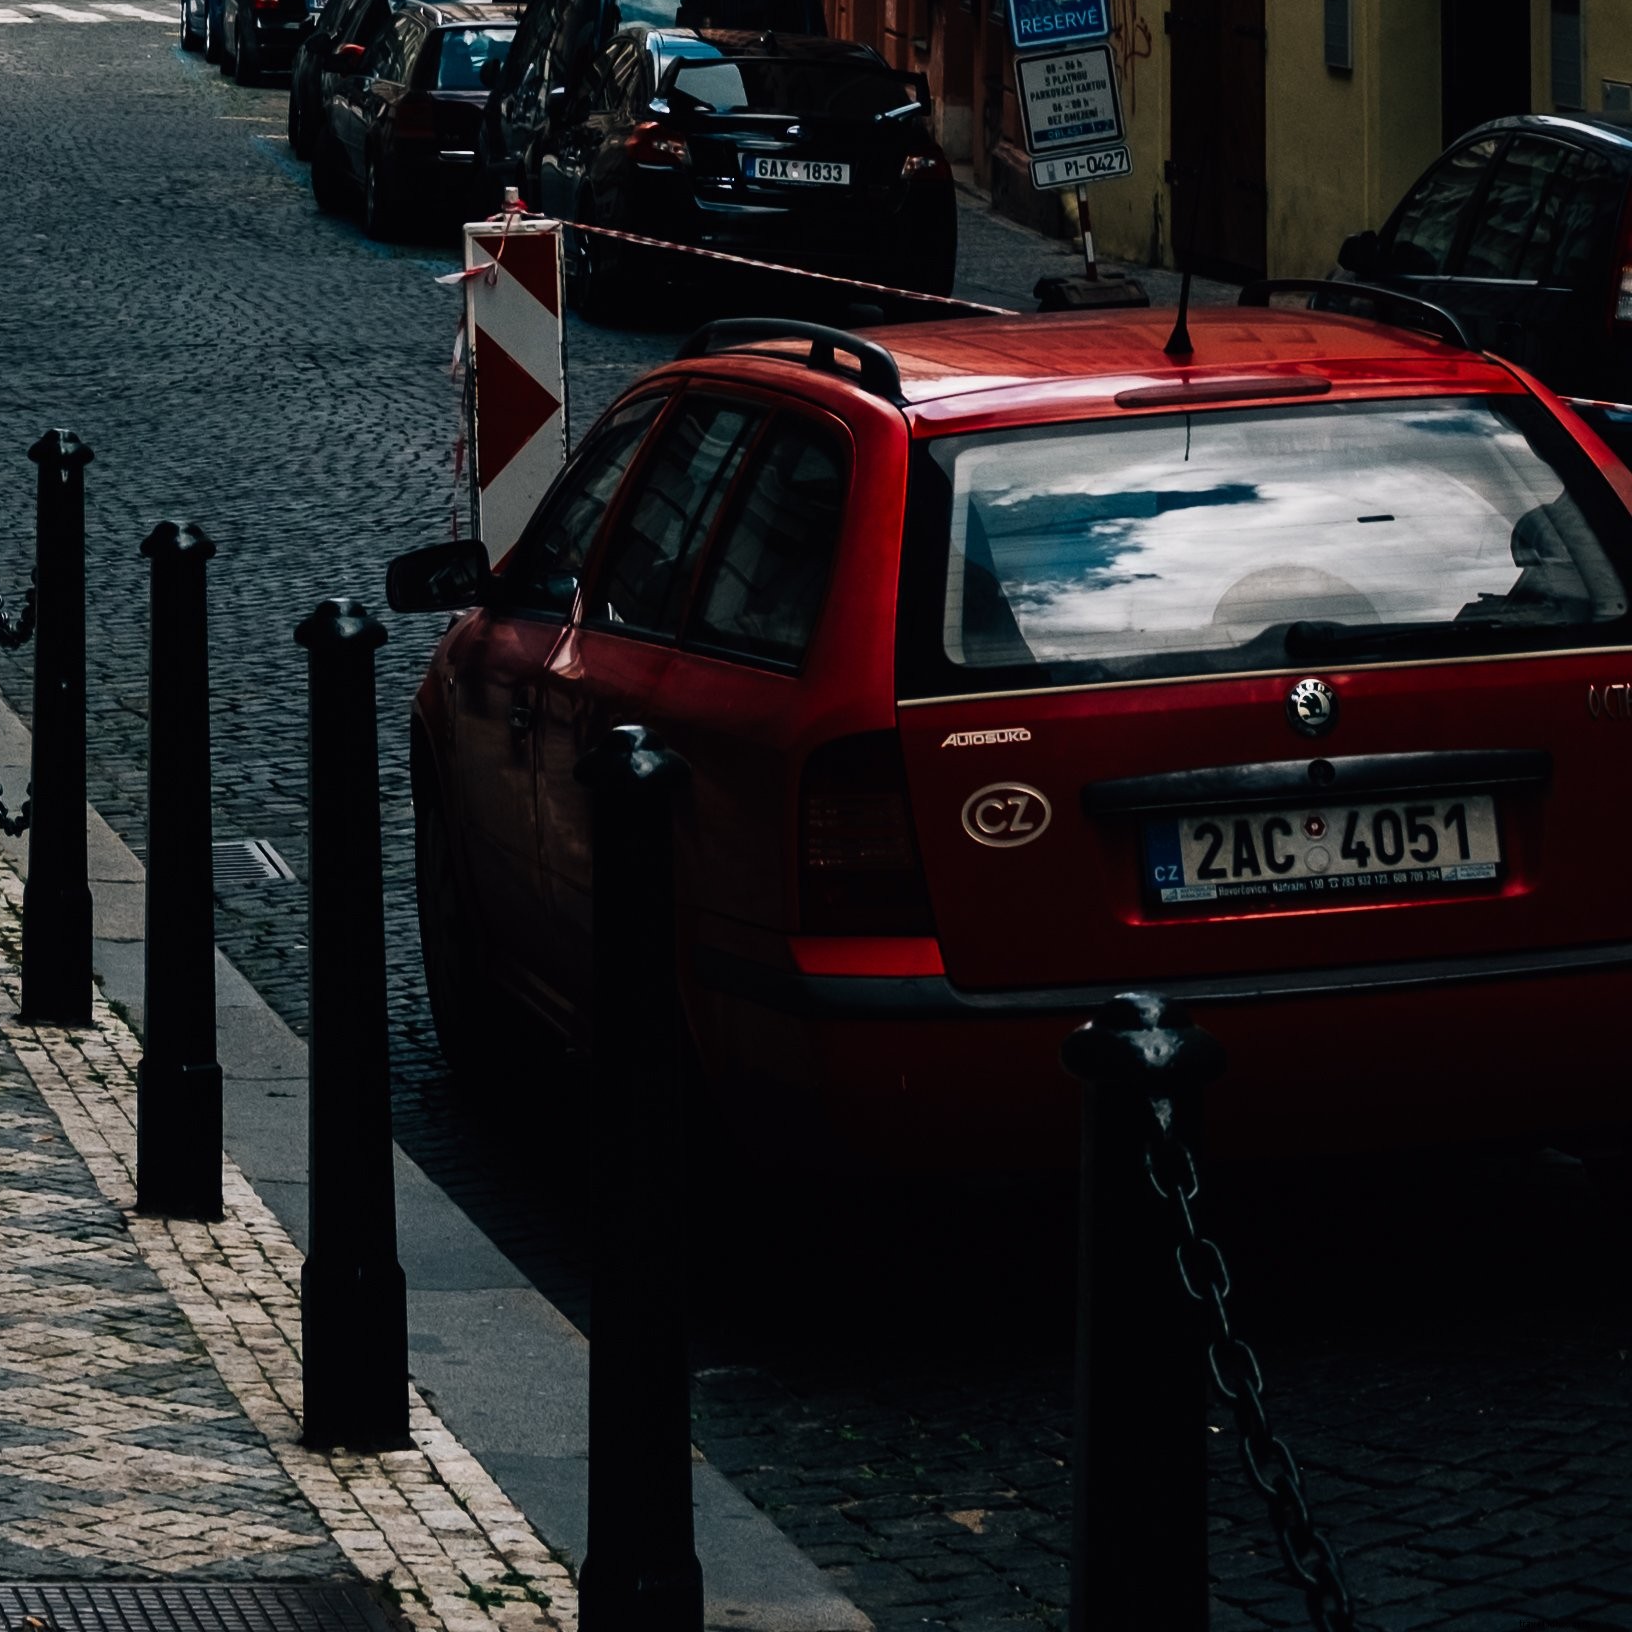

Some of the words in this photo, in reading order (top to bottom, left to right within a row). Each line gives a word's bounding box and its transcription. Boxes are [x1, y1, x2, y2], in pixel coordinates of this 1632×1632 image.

[1052, 71, 1088, 86] PLATNOU
[1076, 79, 1107, 93] KARTOU
[758, 159, 789, 178] 6AX
[803, 163, 843, 182] 1833
[1064, 151, 1125, 177] P1-0427
[975, 795, 1034, 834] CZ
[1193, 816, 1295, 881] 2AC
[1341, 803, 1471, 868] 4051
[1154, 865, 1179, 881] CZ
